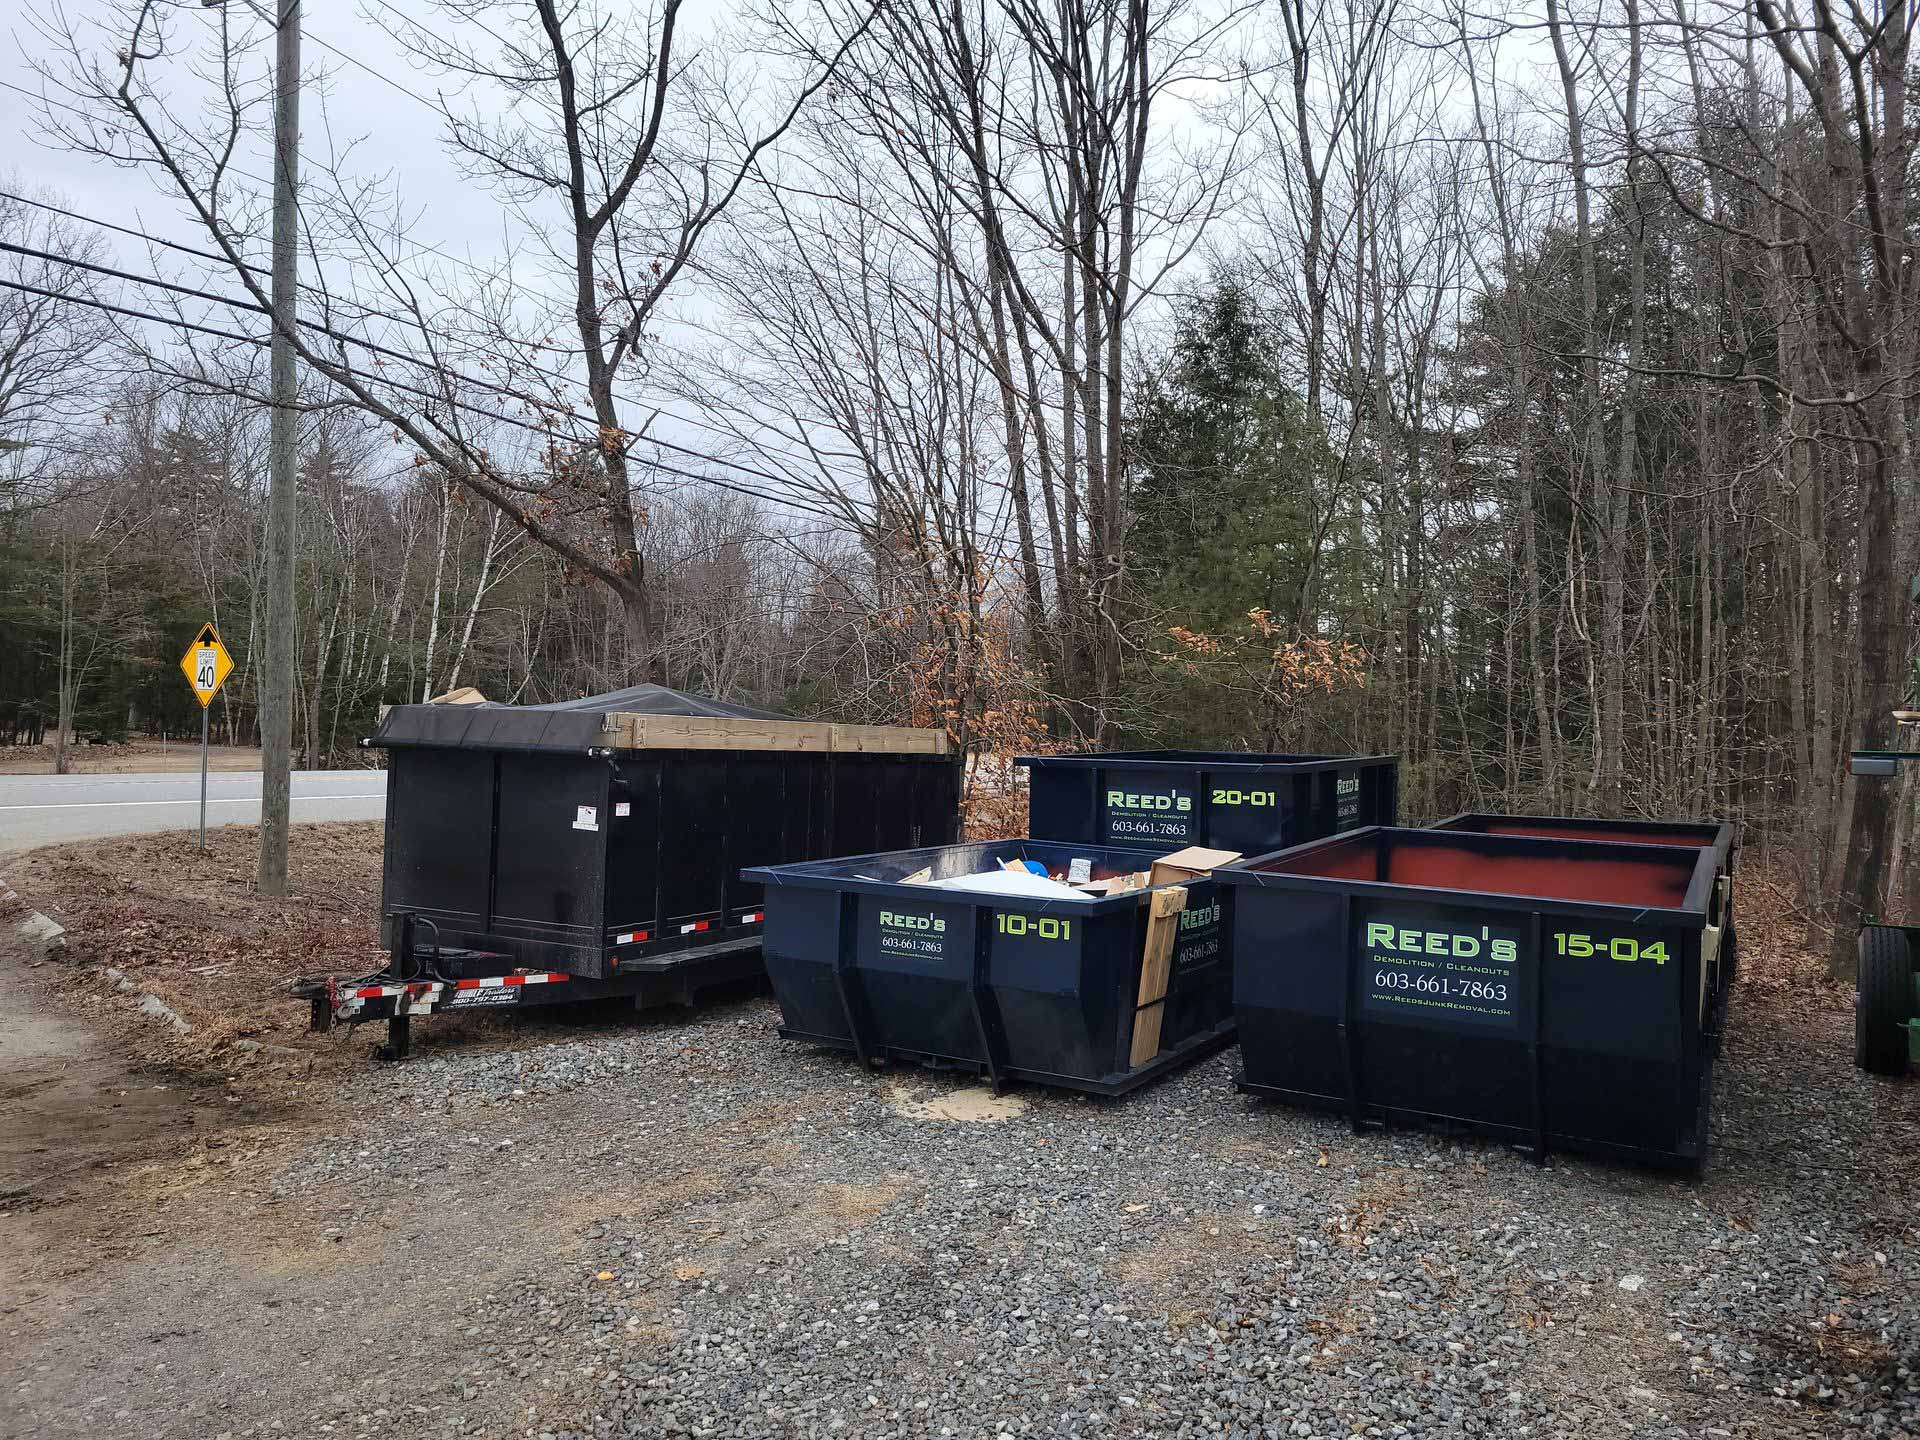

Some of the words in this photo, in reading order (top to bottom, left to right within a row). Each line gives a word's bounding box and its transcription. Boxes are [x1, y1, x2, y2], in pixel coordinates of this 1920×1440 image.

[197, 666, 214, 688] 40
[1107, 789, 1192, 811] REED'S
[1211, 789, 1275, 807] 20-01
[1111, 810, 1147, 818] DEMOLITION
[1112, 820, 1186, 836] 603-661-7863
[879, 911, 946, 932] REED'S
[1180, 896, 1220, 931] REED'S
[882, 928, 911, 937] DEMOLITION
[914, 931, 944, 940] CLEANOUTS
[996, 913, 1071, 941] 10-01
[882, 936, 942, 953] 603-661-7863
[1367, 922, 1517, 962] REED'S
[1553, 933, 1670, 965] 15-04
[1373, 954, 1435, 968] DEMOLITION
[1446, 962, 1510, 976] CLEANOUTS
[1375, 969, 1507, 1001] 603-661-7863
